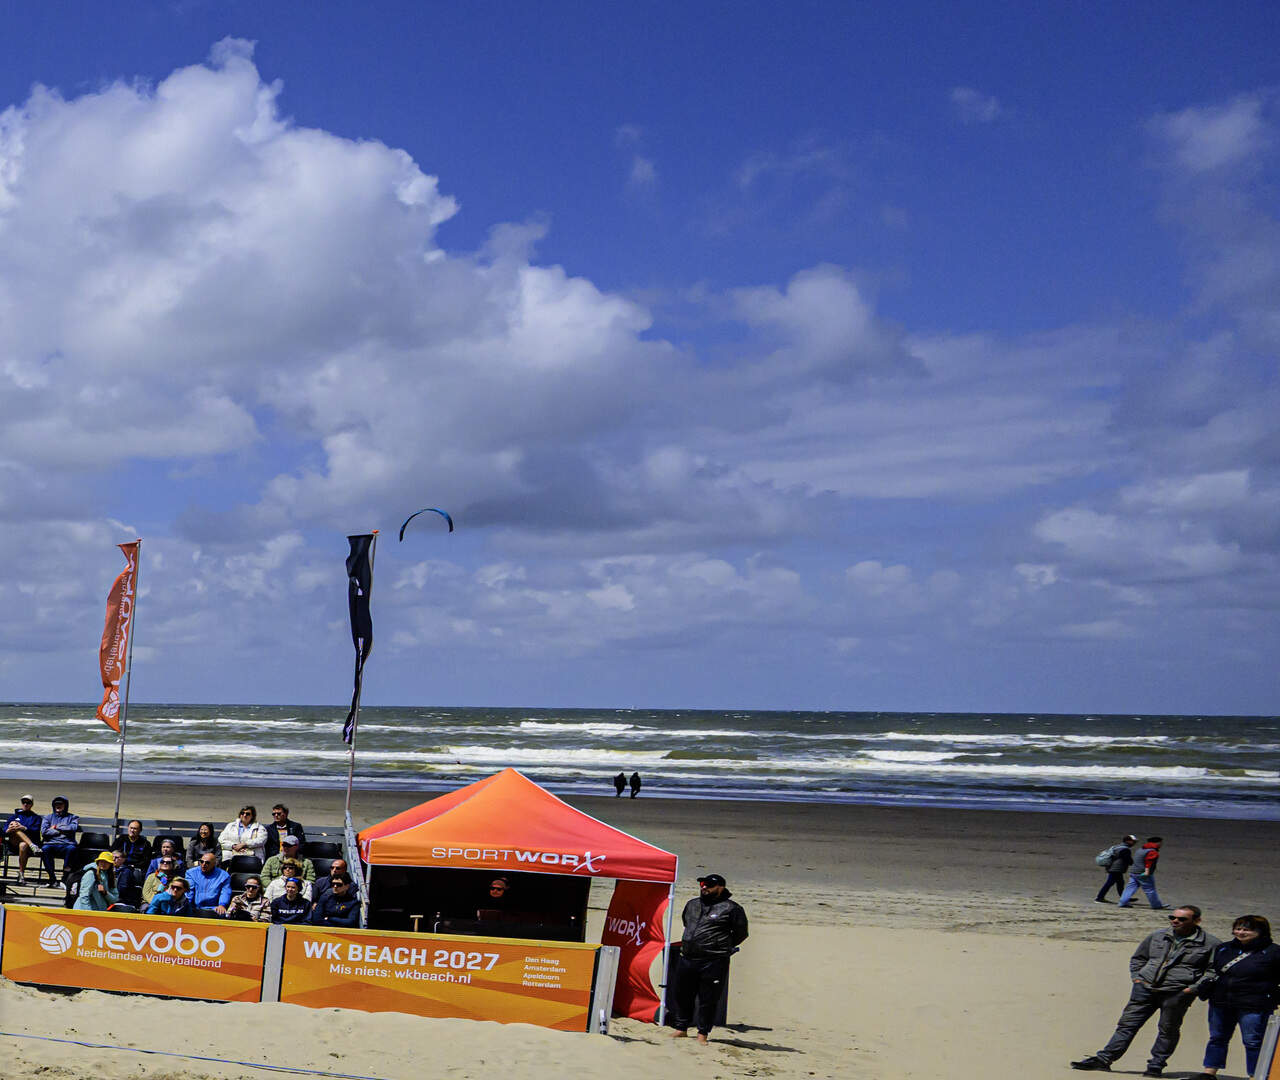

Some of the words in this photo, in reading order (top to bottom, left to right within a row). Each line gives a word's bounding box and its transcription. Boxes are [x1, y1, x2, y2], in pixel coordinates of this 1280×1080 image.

[431, 847, 607, 873] SPORTWORX
[78, 926, 226, 958] nevobo
[76, 948, 143, 962] Nederlandse
[145, 953, 222, 968] Volleybalbond
[304, 941, 342, 961] WK
[347, 943, 427, 967] BEACH
[433, 950, 500, 972] 2027
[525, 956, 539, 964] Den
[540, 957, 560, 966] Haag
[329, 963, 352, 975] Mis
[355, 964, 391, 978] niets:
[394, 968, 472, 984] wkbeach.nl
[522, 972, 560, 982] Apeldoorn
[523, 964, 567, 973] Amsterdam
[522, 980, 562, 989] Rotterdam
